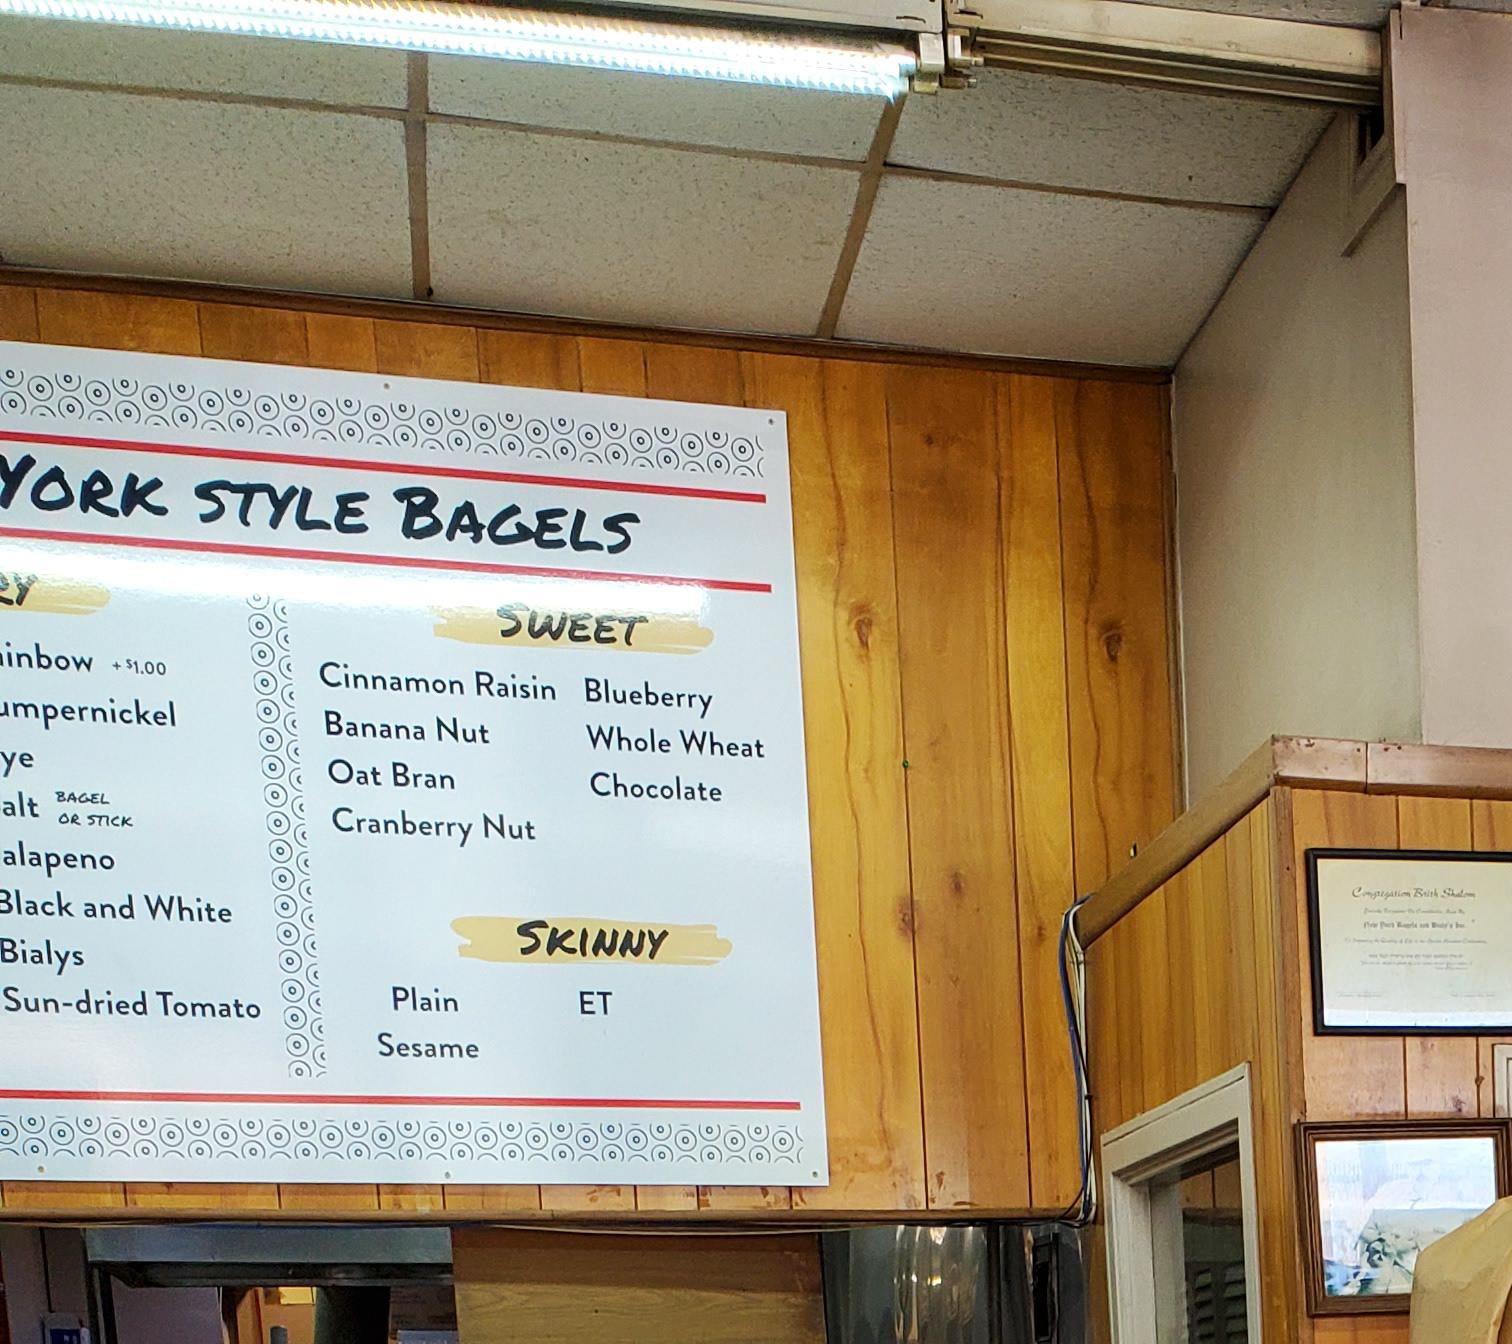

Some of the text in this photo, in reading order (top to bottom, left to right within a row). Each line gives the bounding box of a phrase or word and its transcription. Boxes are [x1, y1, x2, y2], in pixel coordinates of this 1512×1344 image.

[0, 453, 640, 555] YORK STYLE BAGELS
[496, 603, 648, 646] SWEET
[0, 641, 93, 672] inbow
[126, 658, 167, 676] $1.00
[319, 662, 557, 701] Cinnamon Raisin
[585, 678, 713, 719] Blueberry
[0, 697, 176, 731] umpernickel
[324, 711, 490, 745] Banana Nut
[586, 725, 765, 758] Whole Wheat
[0, 751, 34, 778] ye
[327, 759, 456, 790] Oat Bran
[55, 791, 110, 805] BAGEL
[590, 772, 723, 802] Chocolate
[0, 791, 40, 818] alt
[58, 813, 134, 827] OR STICK
[331, 807, 537, 848] Cranberry Nut
[2, 840, 115, 878] alapeno
[0, 889, 233, 923] Black and White
[516, 919, 669, 960] SKINNY
[0, 938, 85, 976] Bialys
[3, 986, 261, 1019] Sun-dried Tomato
[391, 986, 613, 1015] Plain ET
[377, 1032, 479, 1058] Sesame
